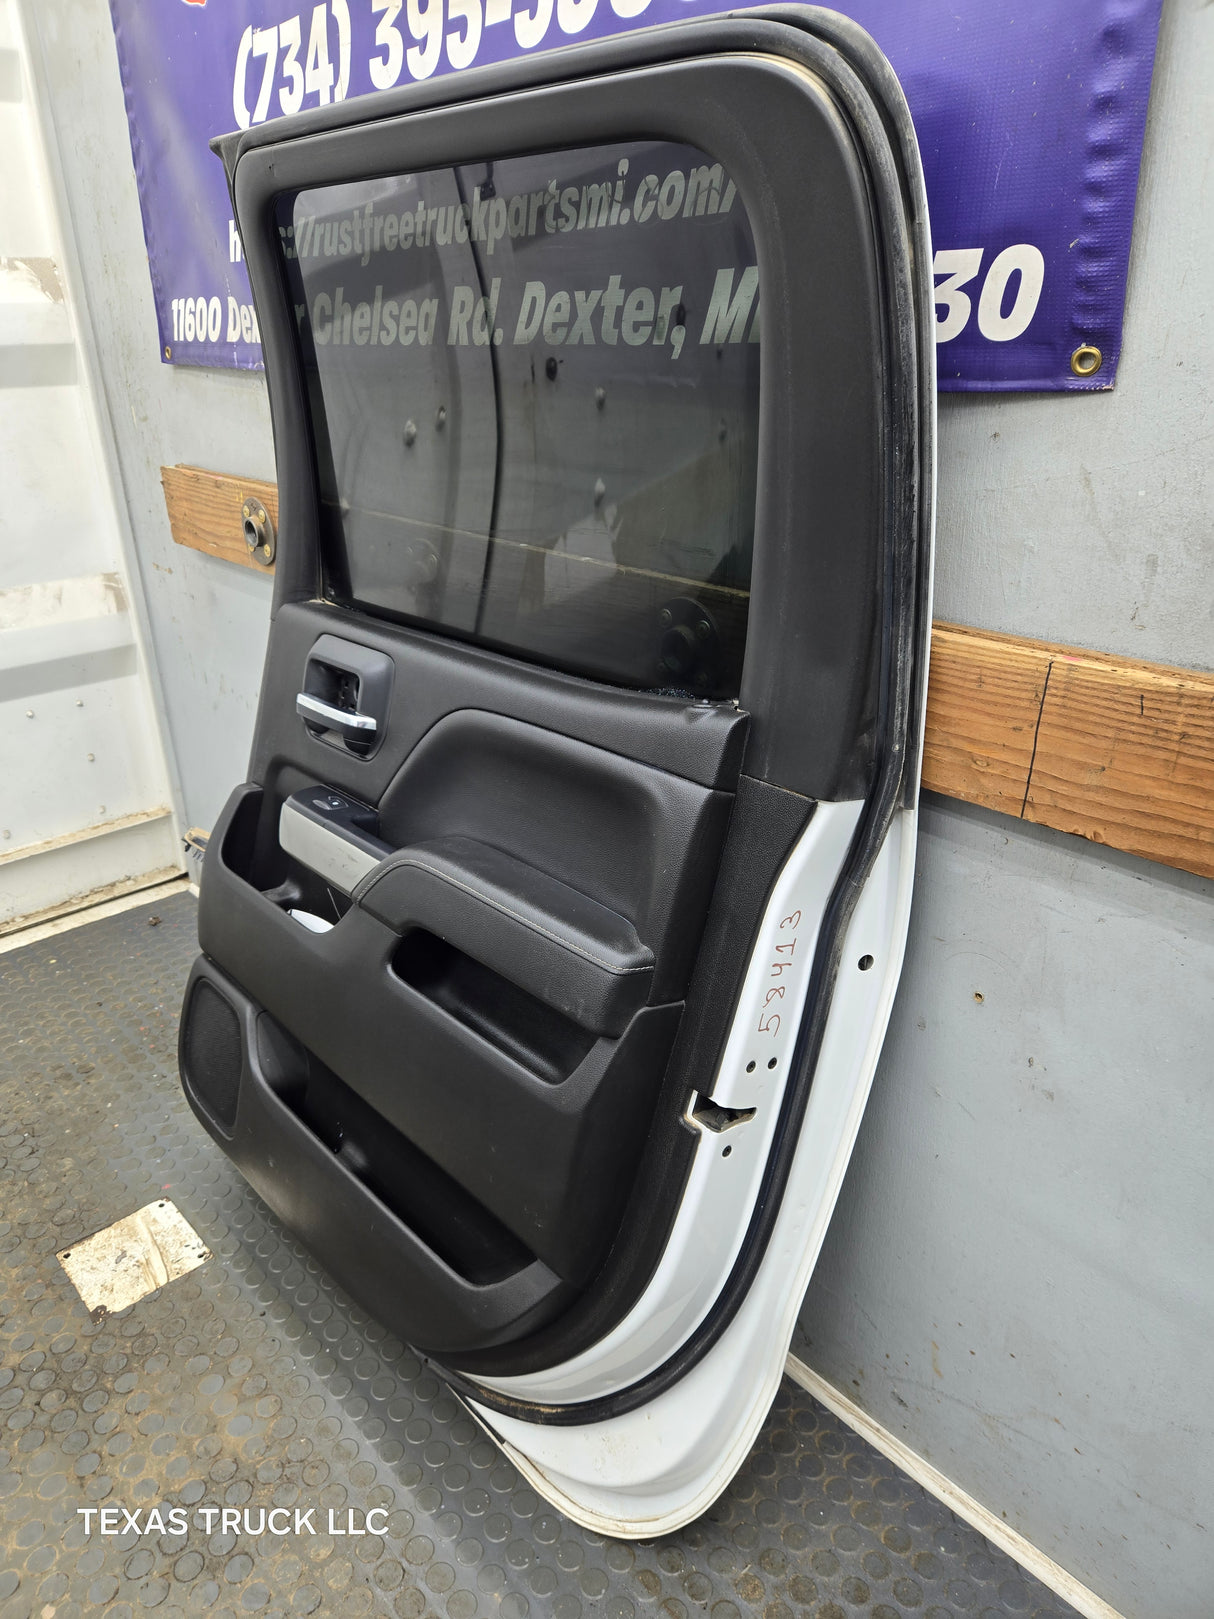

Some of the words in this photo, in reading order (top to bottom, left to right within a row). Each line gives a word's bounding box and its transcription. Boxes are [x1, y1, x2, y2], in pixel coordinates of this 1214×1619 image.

[233, 0, 351, 130] (734)
[172, 296, 222, 343] 11600
[312, 285, 439, 346] Chelsea
[447, 277, 504, 346] Rd.
[513, 275, 686, 360] Dexter,
[758, 910, 801, 1037] 58413
